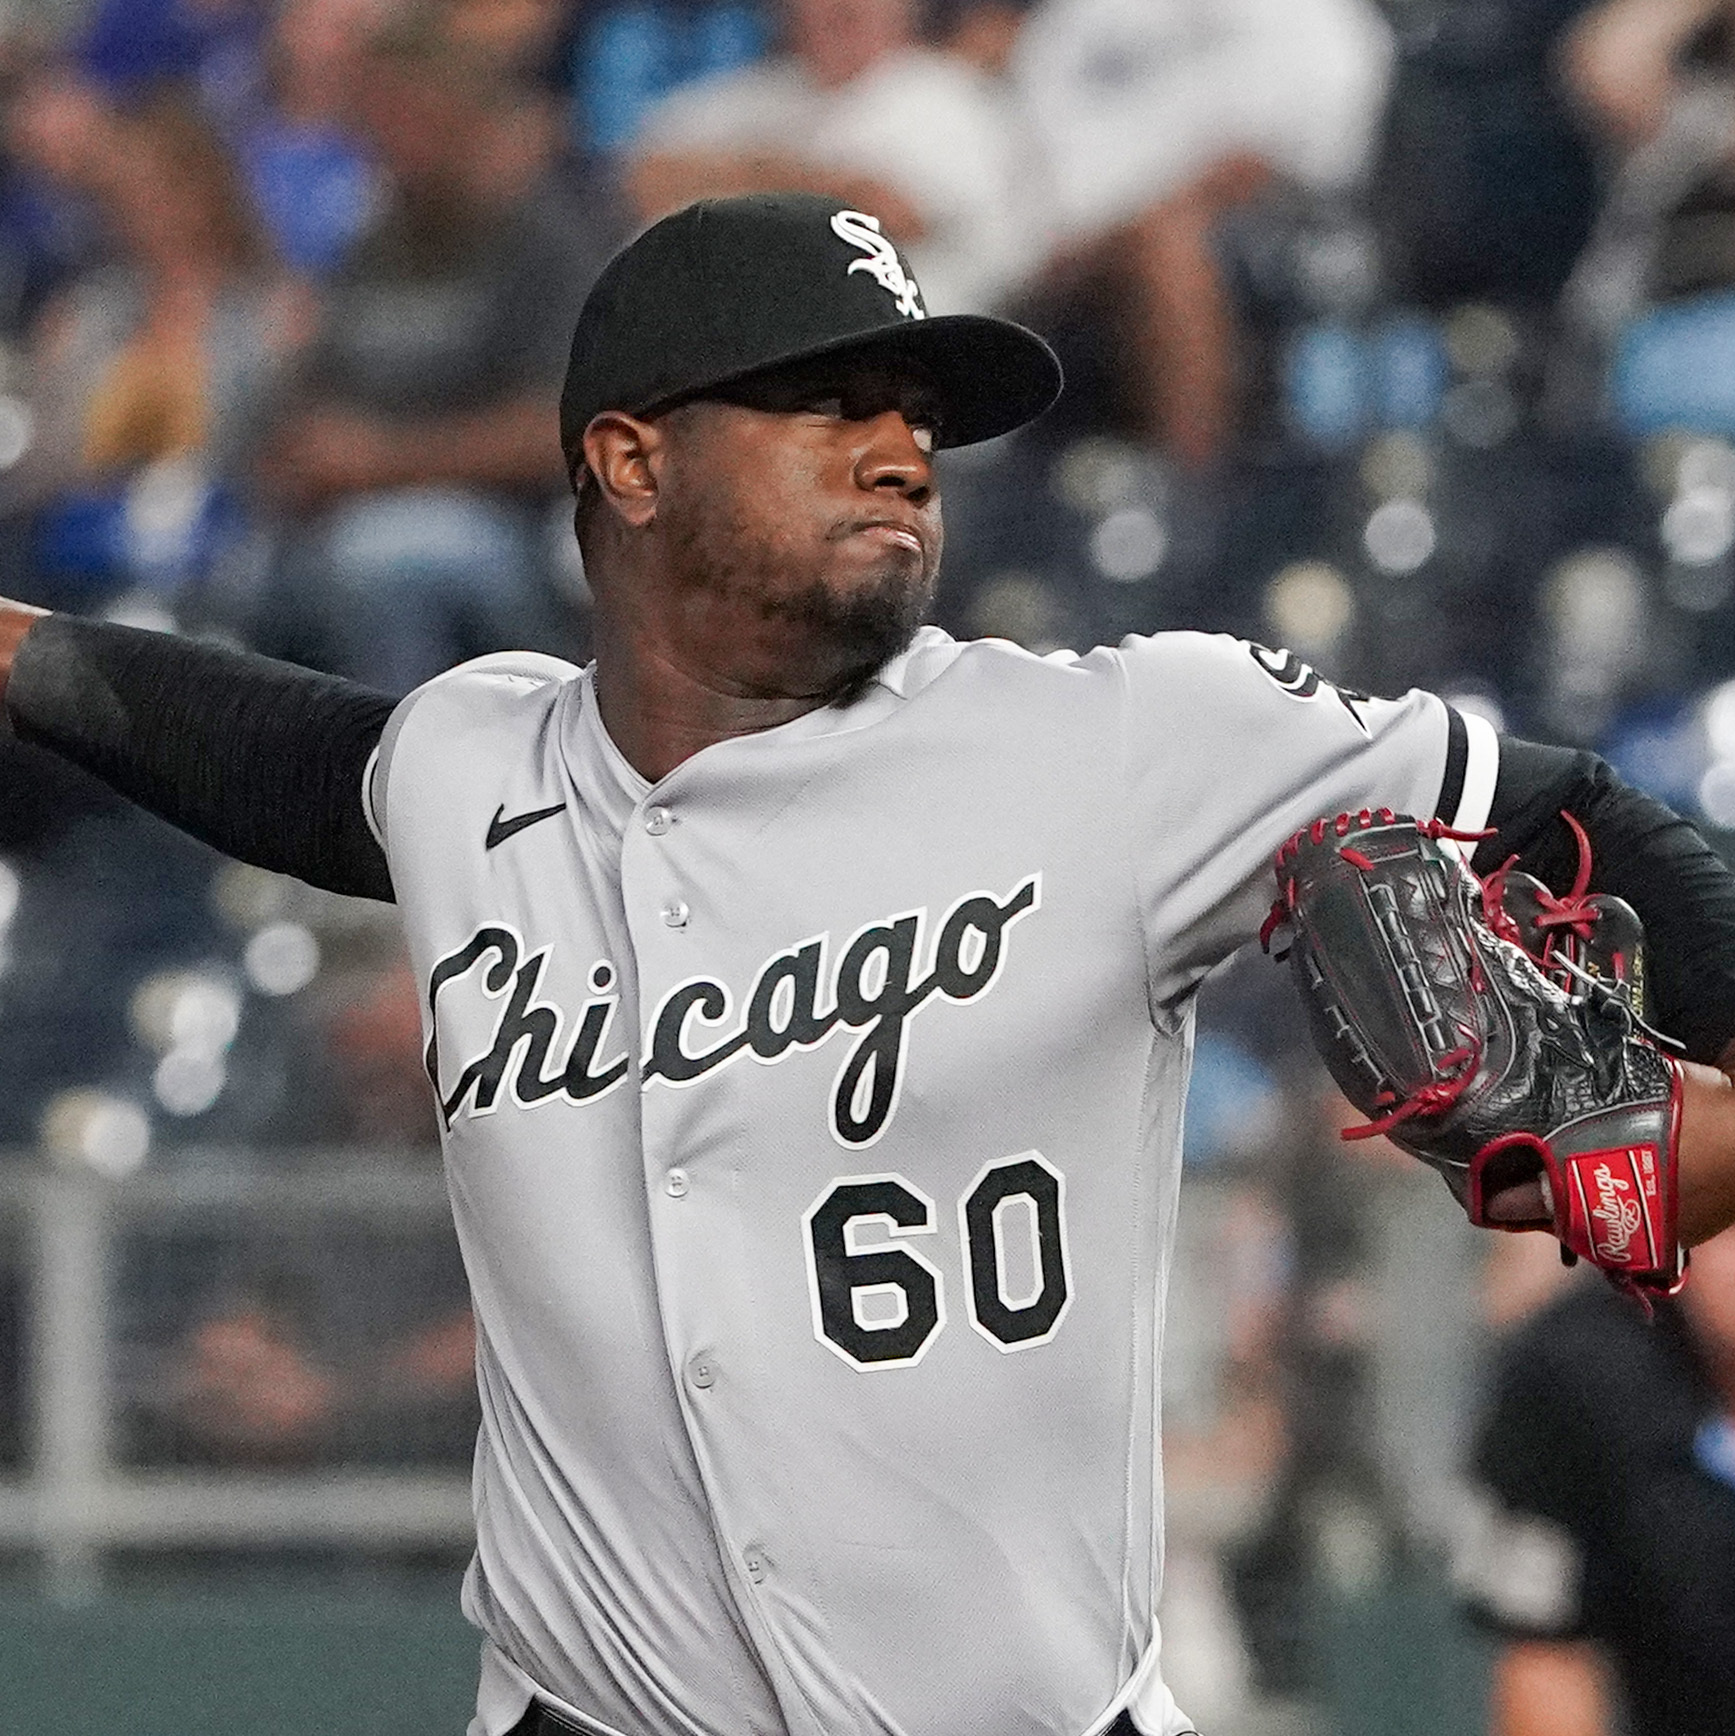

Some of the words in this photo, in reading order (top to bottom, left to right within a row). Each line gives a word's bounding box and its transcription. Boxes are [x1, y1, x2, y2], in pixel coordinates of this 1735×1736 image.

[422, 870, 1043, 1150] Chicago
[801, 1150, 1075, 1374] 60
[1592, 1162, 1632, 1263] Rawlings
